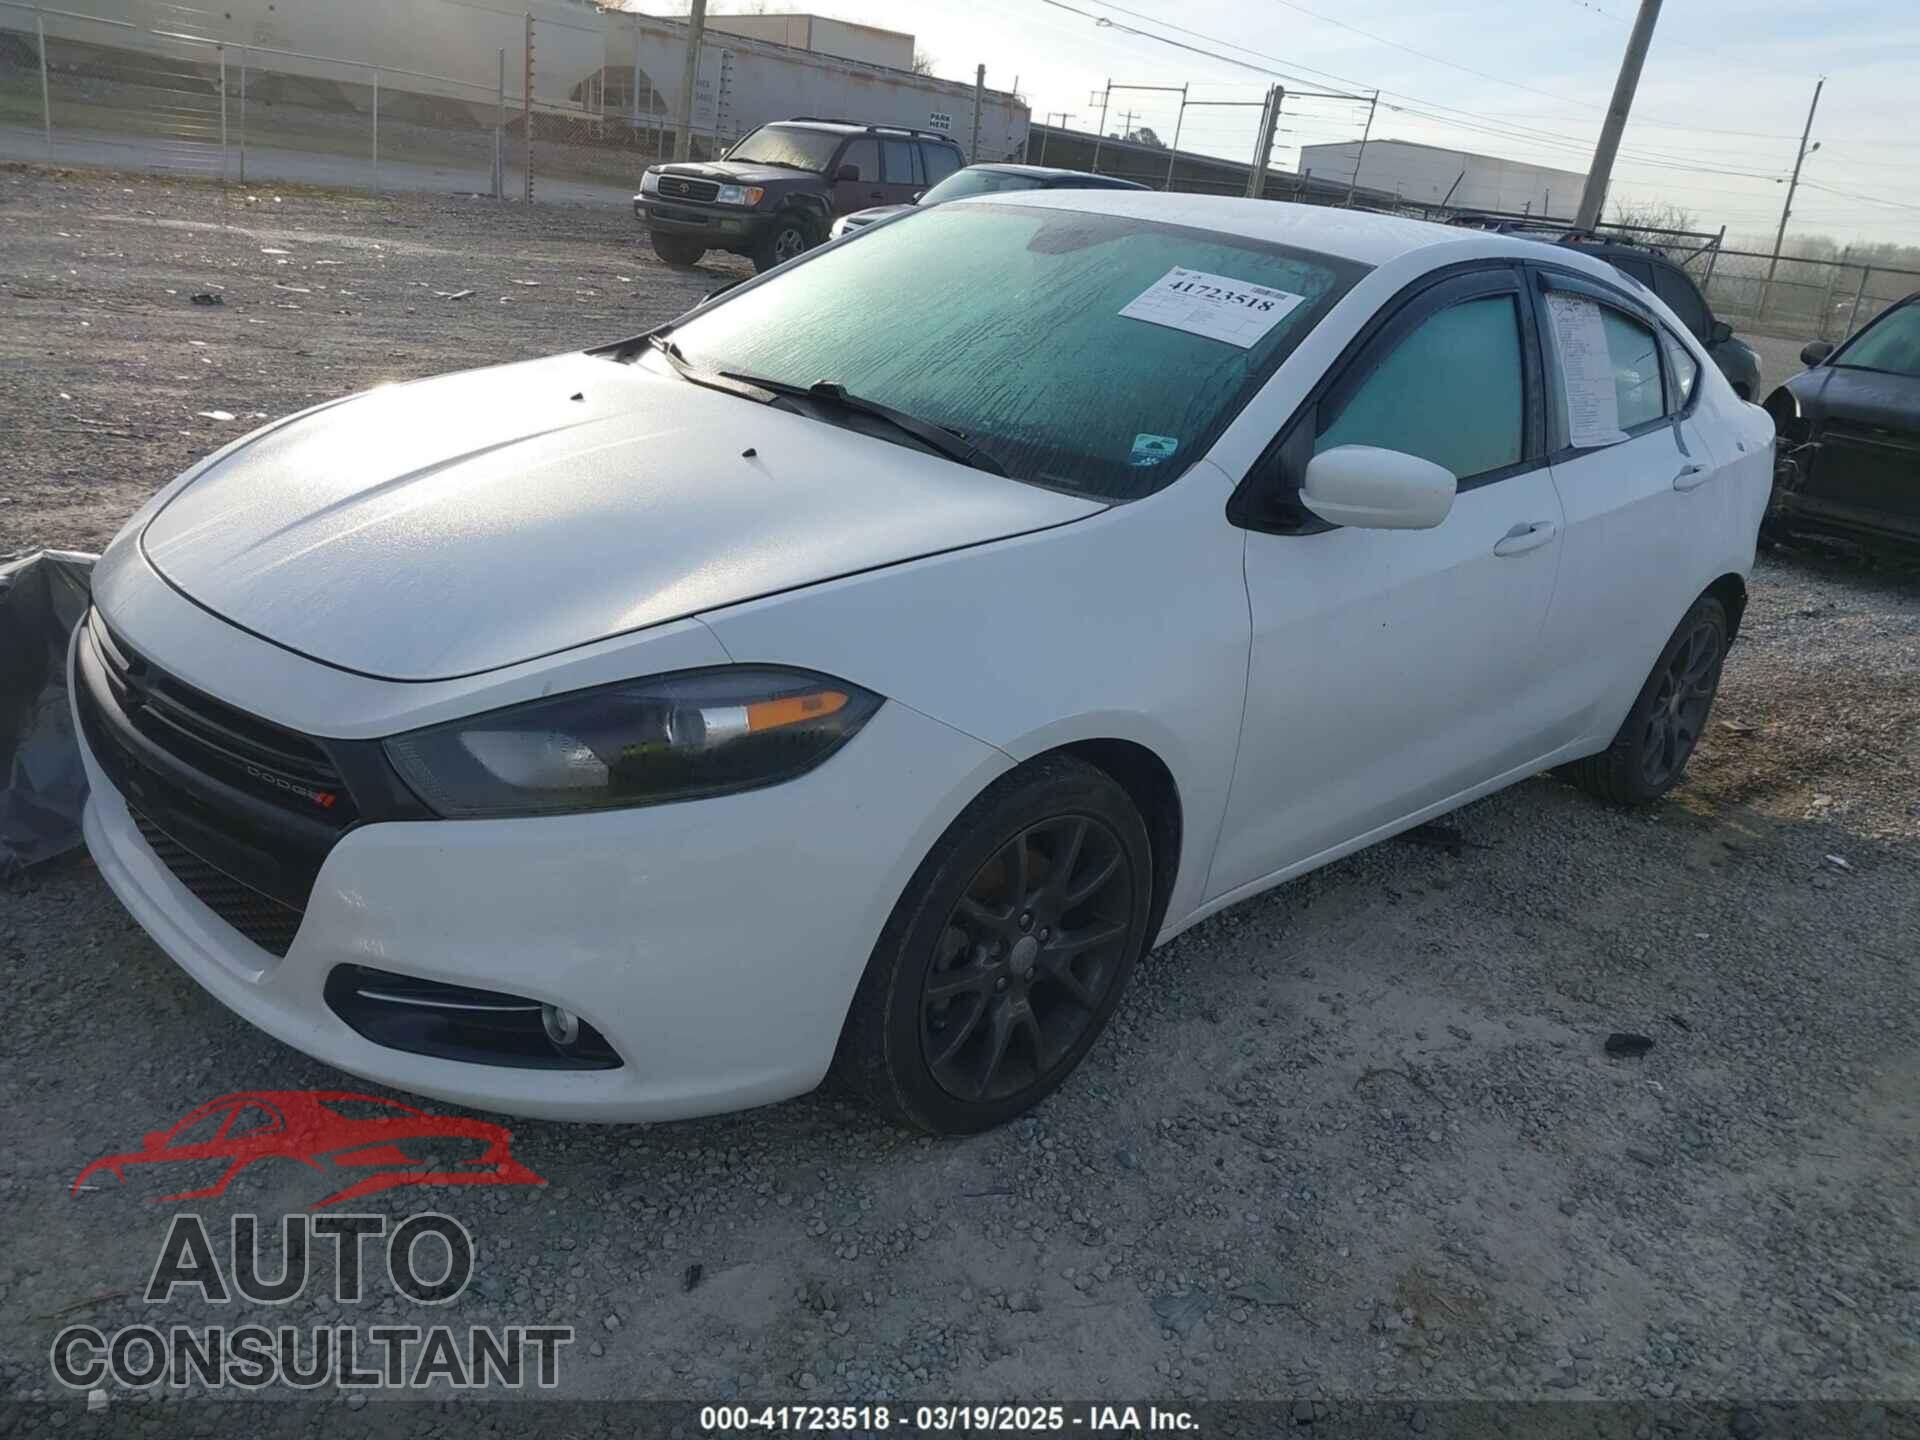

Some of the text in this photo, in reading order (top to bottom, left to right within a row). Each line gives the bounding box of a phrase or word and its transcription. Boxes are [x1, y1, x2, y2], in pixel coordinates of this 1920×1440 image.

[930, 112, 950, 121] PARK
[930, 121, 950, 130] HERE
[1169, 281, 1275, 312] 41723518
